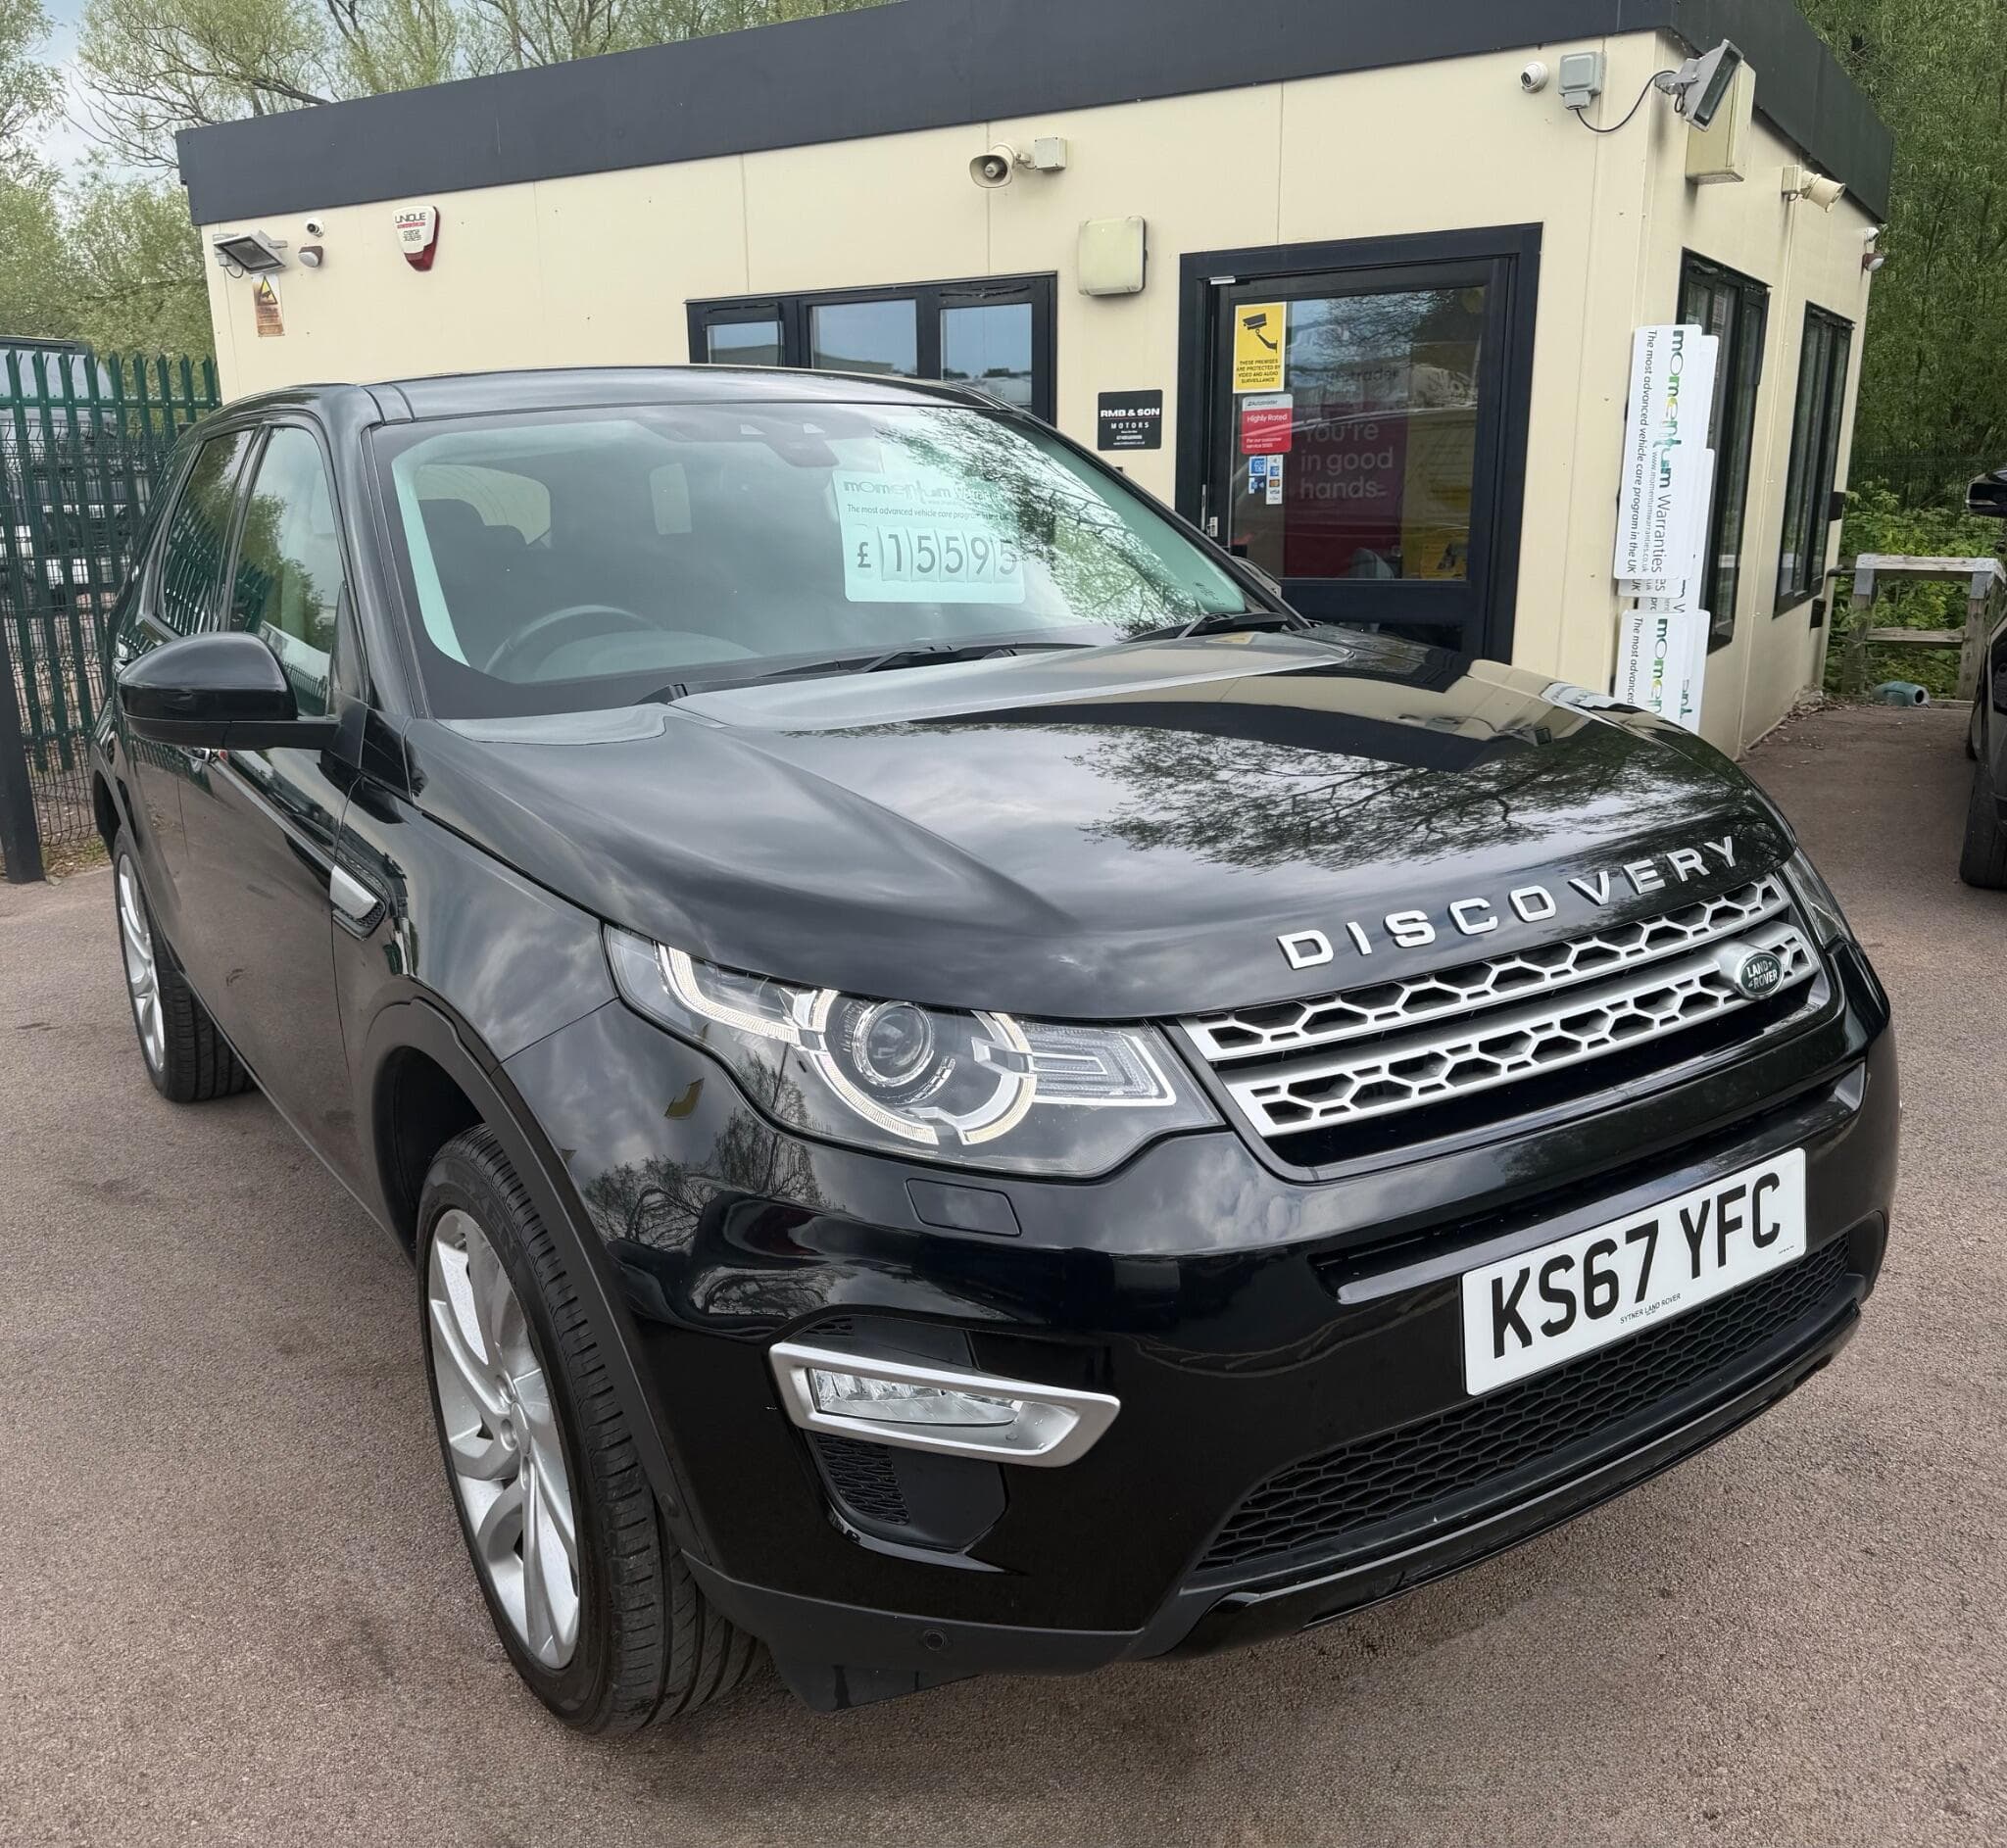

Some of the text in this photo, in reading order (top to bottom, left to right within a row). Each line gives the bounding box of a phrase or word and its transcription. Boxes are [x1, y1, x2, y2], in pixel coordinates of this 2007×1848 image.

[1127, 409, 1136, 417] &
[1137, 408, 1160, 416] SON
[1247, 413, 1288, 423] Highly Rated
[1653, 330, 1684, 488] momentum
[1300, 446, 1394, 475] in good
[1627, 330, 1657, 574] The most advanced vehicle care program in the UK
[843, 479, 952, 504] momentum
[847, 504, 859, 512] The
[861, 505, 878, 513] most
[879, 507, 912, 516] advanced
[914, 508, 936, 517] vehicle
[1651, 494, 1672, 573] Warranties
[1627, 617, 1643, 705] The most advanced
[1645, 618, 1668, 713] momen
[1277, 836, 1738, 969] DISCOVERY
[1746, 960, 1768, 978] LAND
[1753, 969, 1778, 990] ROVER
[1492, 1172, 1781, 1359] KS67 YFC
[1620, 1292, 1681, 1324] SYTNER LAND ROVER
